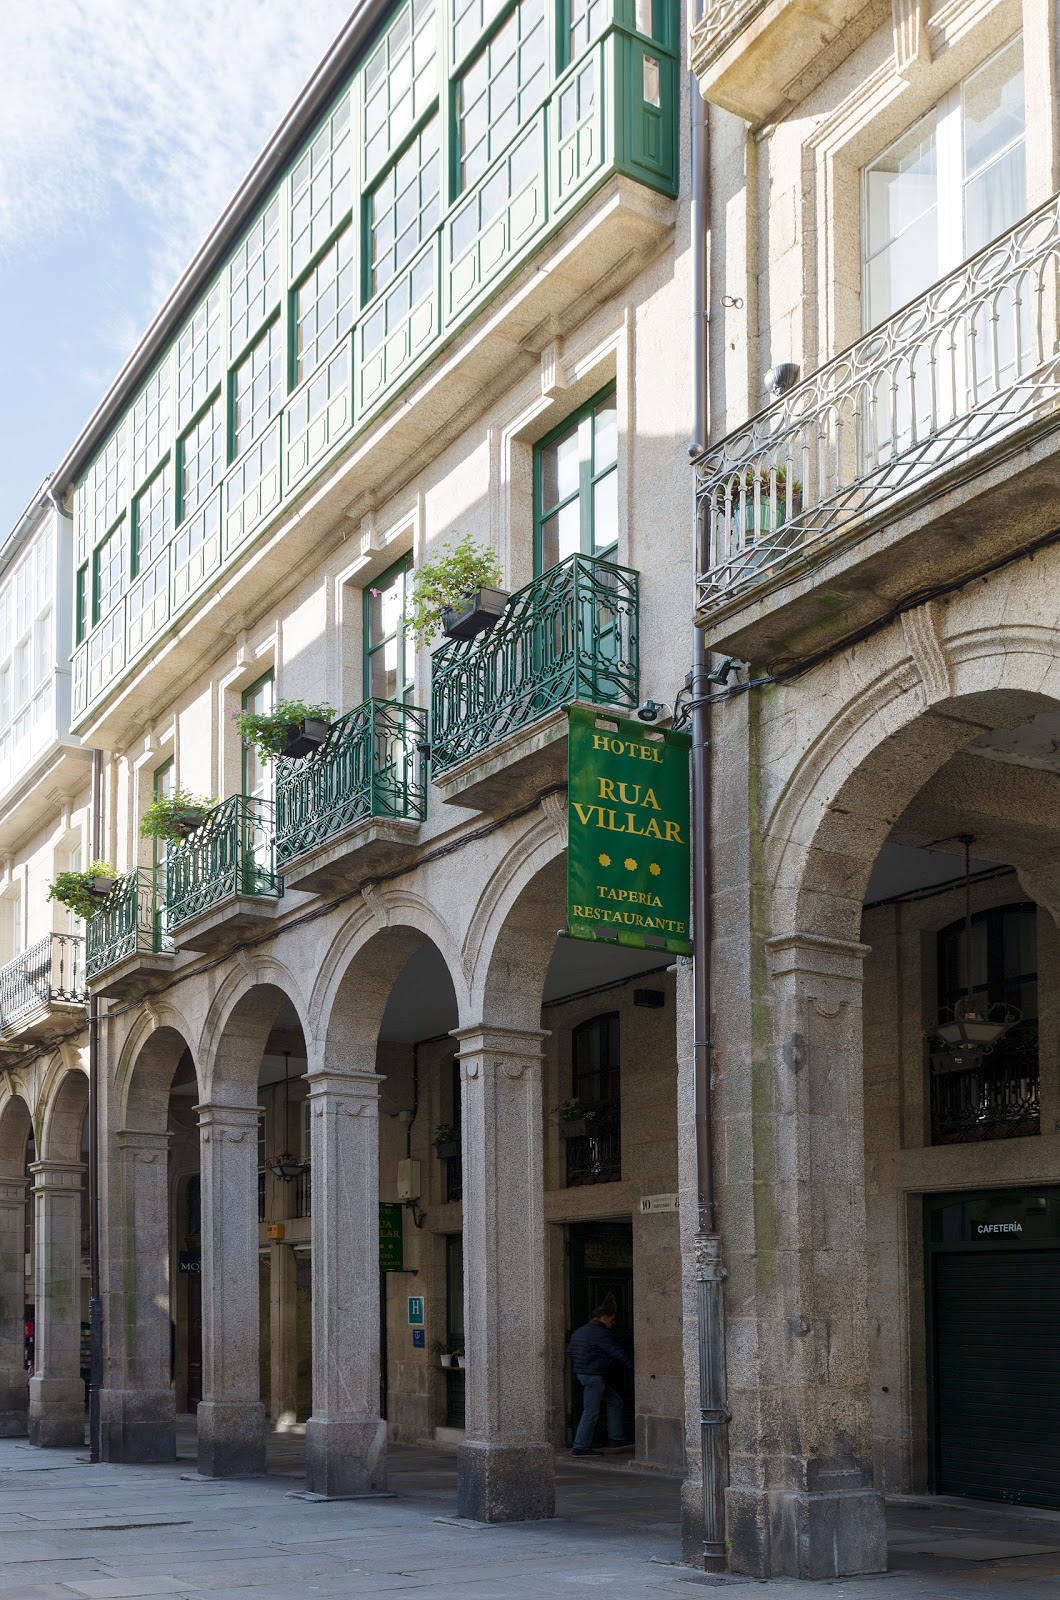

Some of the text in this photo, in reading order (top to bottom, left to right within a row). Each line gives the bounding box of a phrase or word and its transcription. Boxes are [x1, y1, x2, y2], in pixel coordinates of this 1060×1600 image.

[593, 735, 664, 763] HOTEL
[598, 777, 662, 811] RUA
[572, 802, 684, 843] VILLAR
[597, 886, 663, 907] TAPERÍA
[573, 905, 685, 933] RESTAURANTE
[642, 1199, 651, 1210] 10
[977, 1221, 1023, 1233] CAFETERÍA
[181, 1262, 201, 1270] MO
[412, 1300, 420, 1314] H
